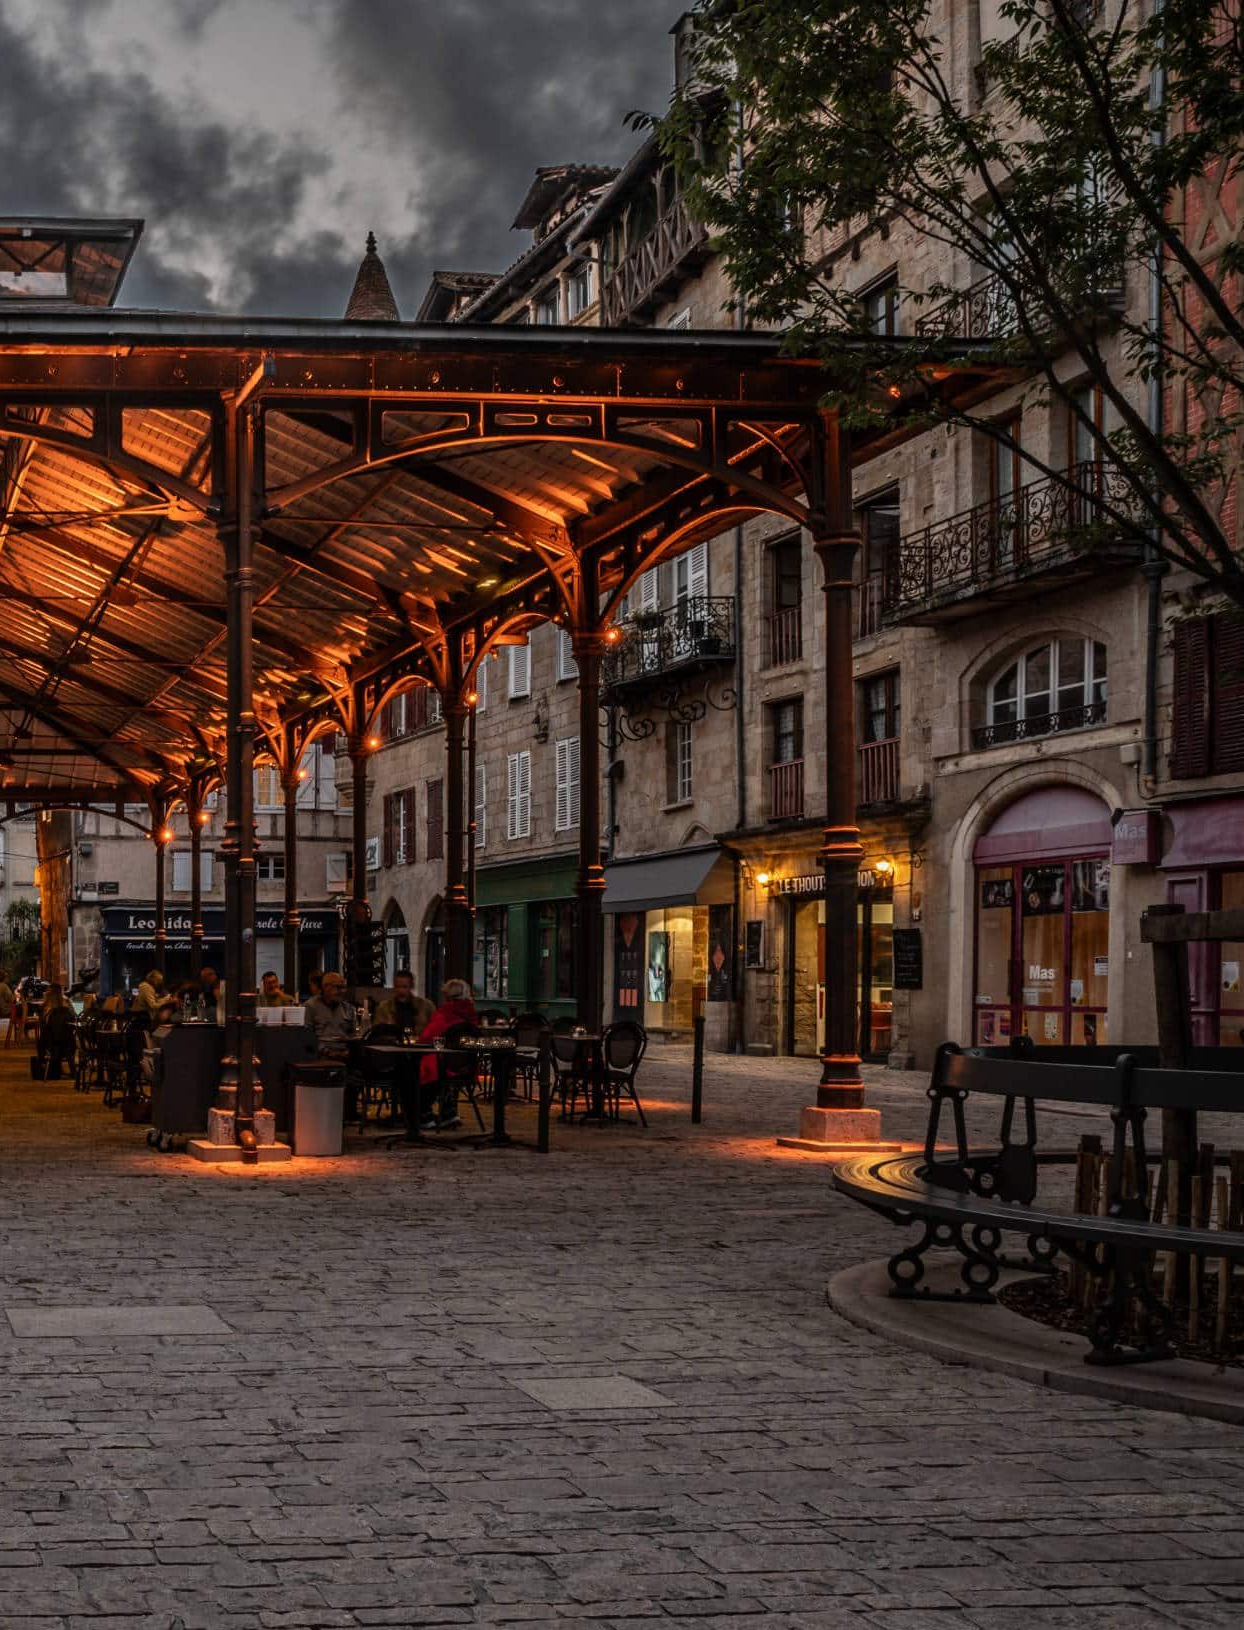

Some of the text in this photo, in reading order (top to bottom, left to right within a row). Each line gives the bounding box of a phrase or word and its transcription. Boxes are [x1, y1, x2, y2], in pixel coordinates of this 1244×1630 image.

[778, 878, 791, 894] LE
[128, 915, 192, 930] Leoida
[1028, 964, 1056, 980] Mas
